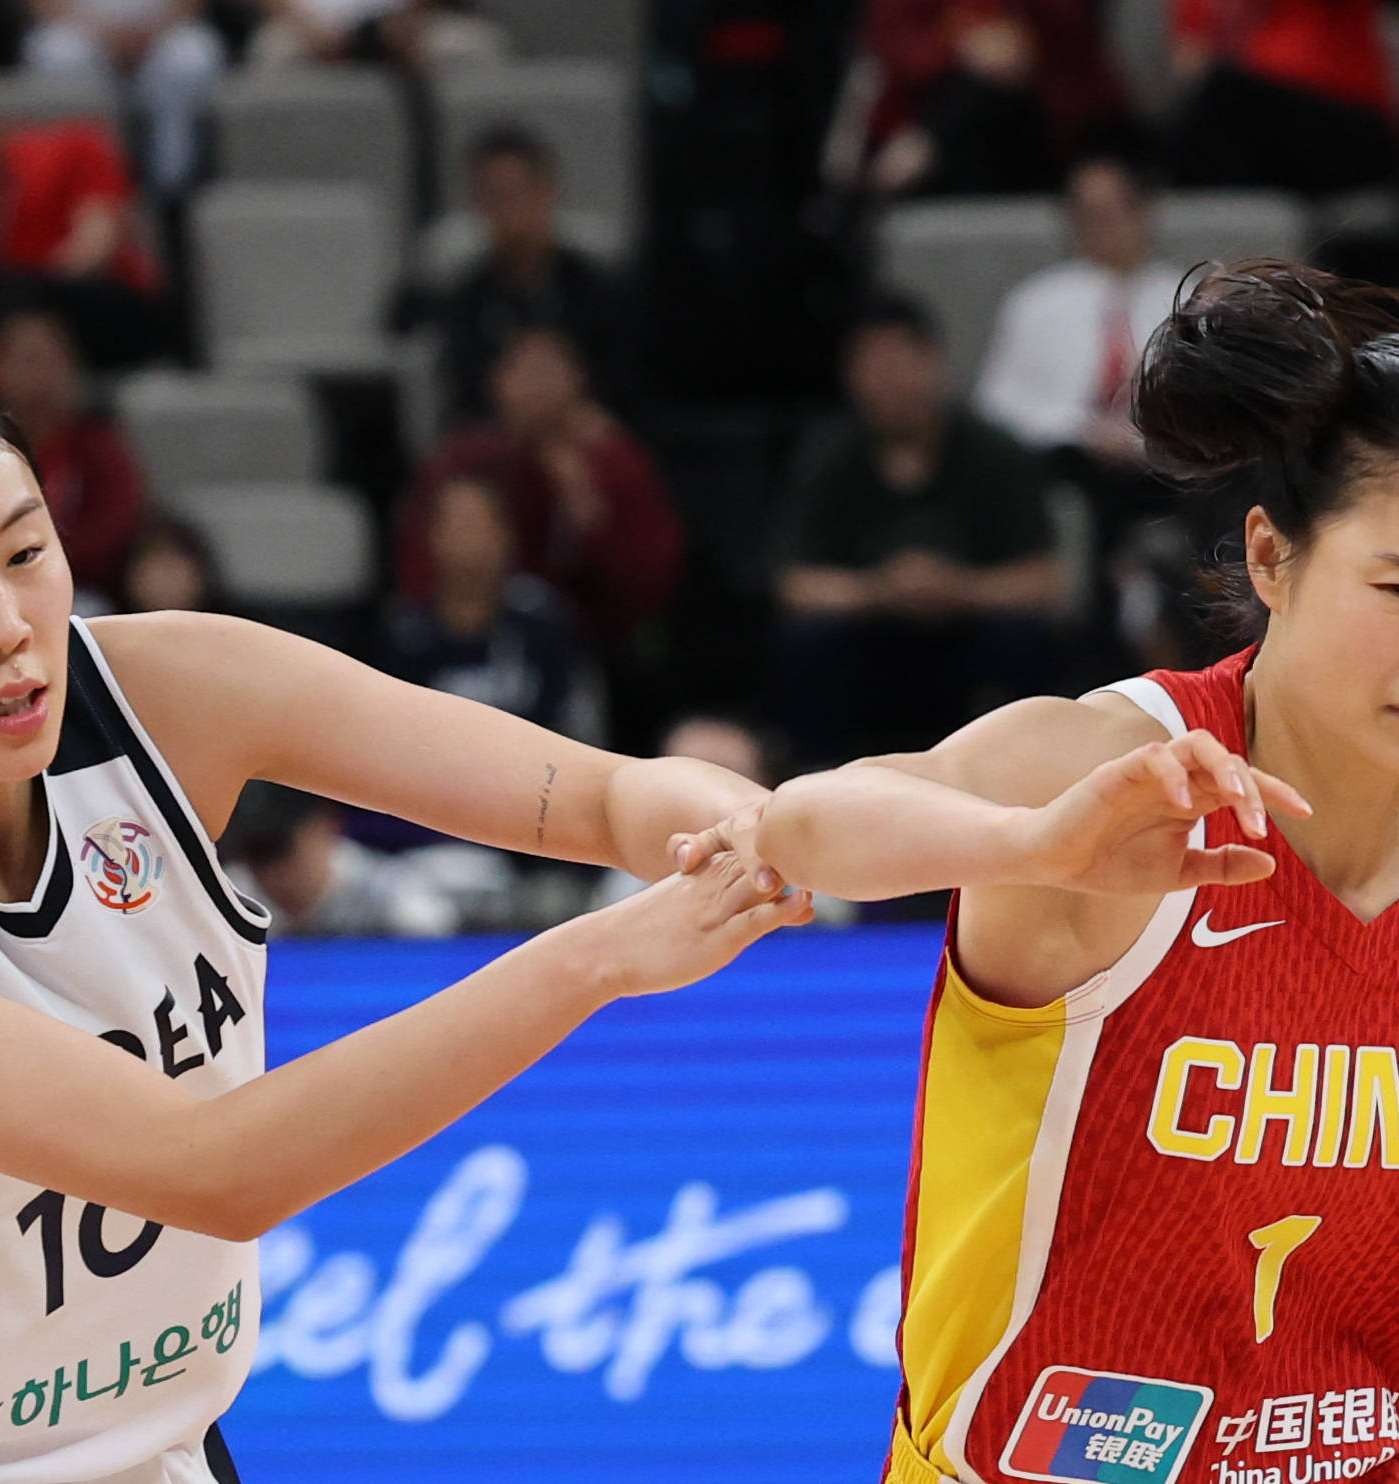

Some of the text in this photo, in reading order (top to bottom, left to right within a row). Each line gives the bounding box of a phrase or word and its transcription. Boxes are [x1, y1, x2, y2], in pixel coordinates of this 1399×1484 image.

[16, 1188, 164, 1316] 10
[1248, 1214, 1322, 1343] 1
[11, 1278, 242, 1427] 하나은행
[1037, 1393, 1184, 1453] UnionPay
[1084, 1433, 1164, 1473] 银联
